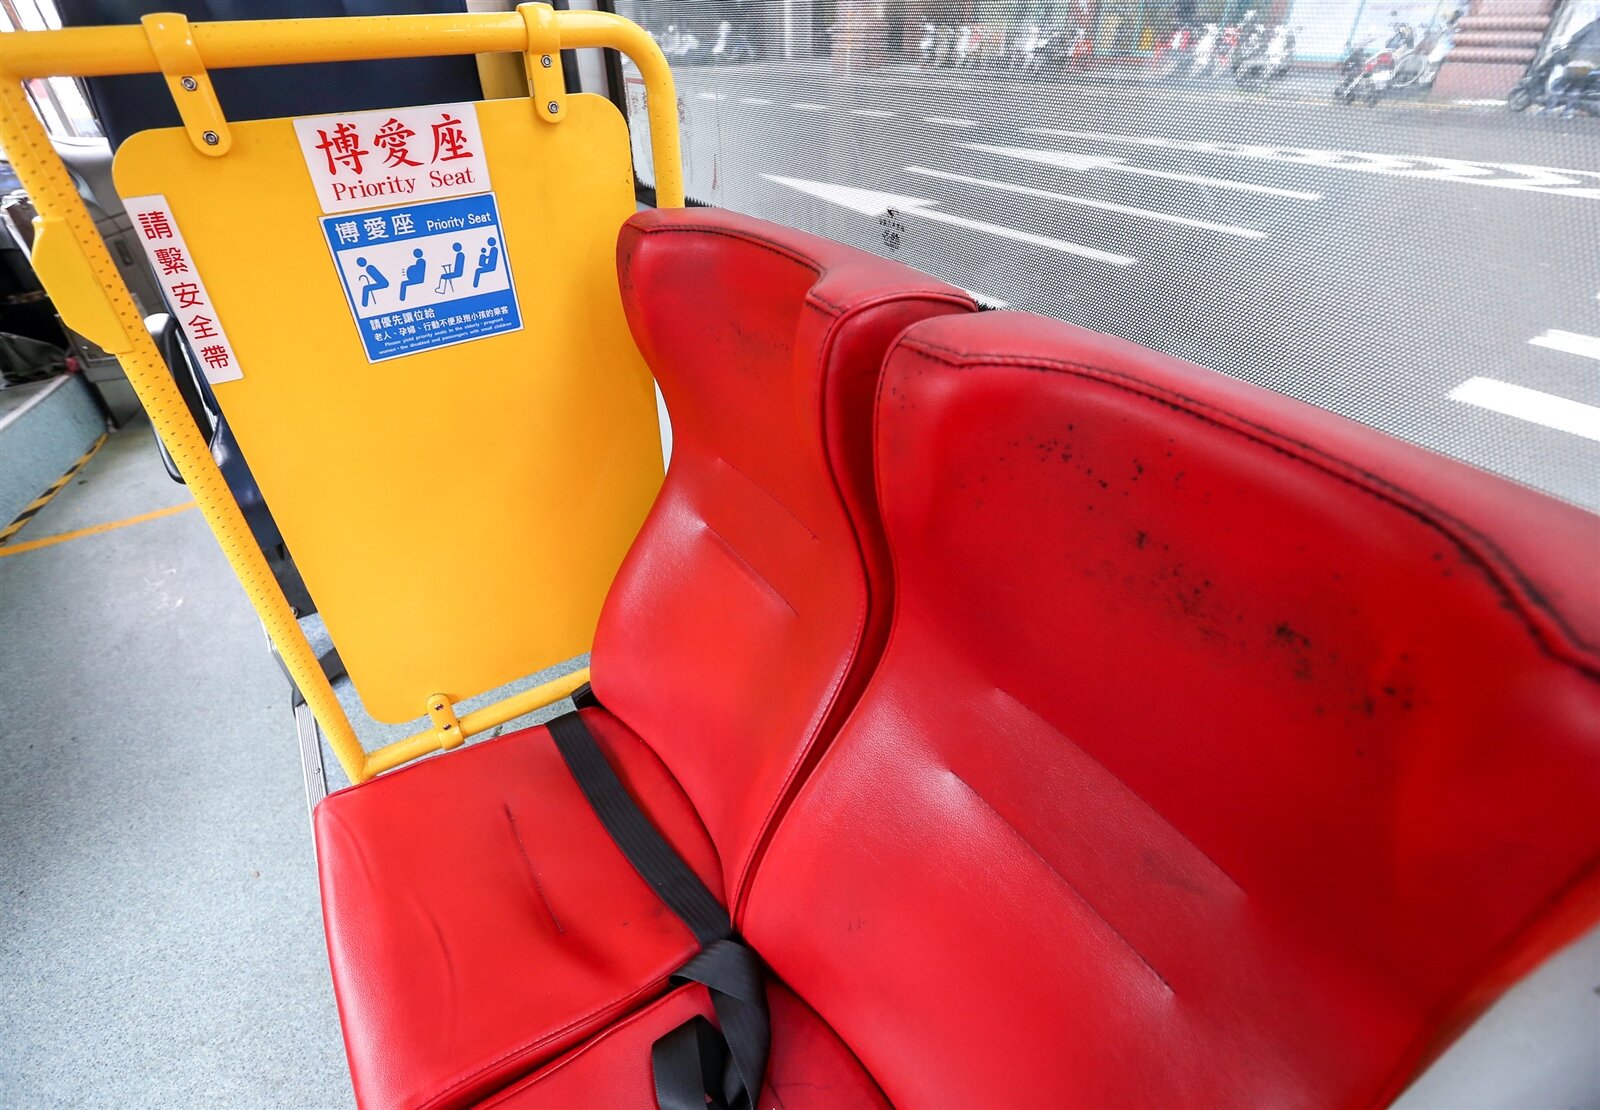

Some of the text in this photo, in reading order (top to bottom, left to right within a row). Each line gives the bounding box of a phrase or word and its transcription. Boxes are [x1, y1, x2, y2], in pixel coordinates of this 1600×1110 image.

[315, 114, 474, 175] 博愛座
[332, 167, 475, 200] Priority Seat
[335, 213, 416, 244] 博愛座
[427, 212, 492, 231] Priority Seat
[137, 210, 229, 369] 請繫安全帶
[370, 307, 435, 330] 請優先讓位給
